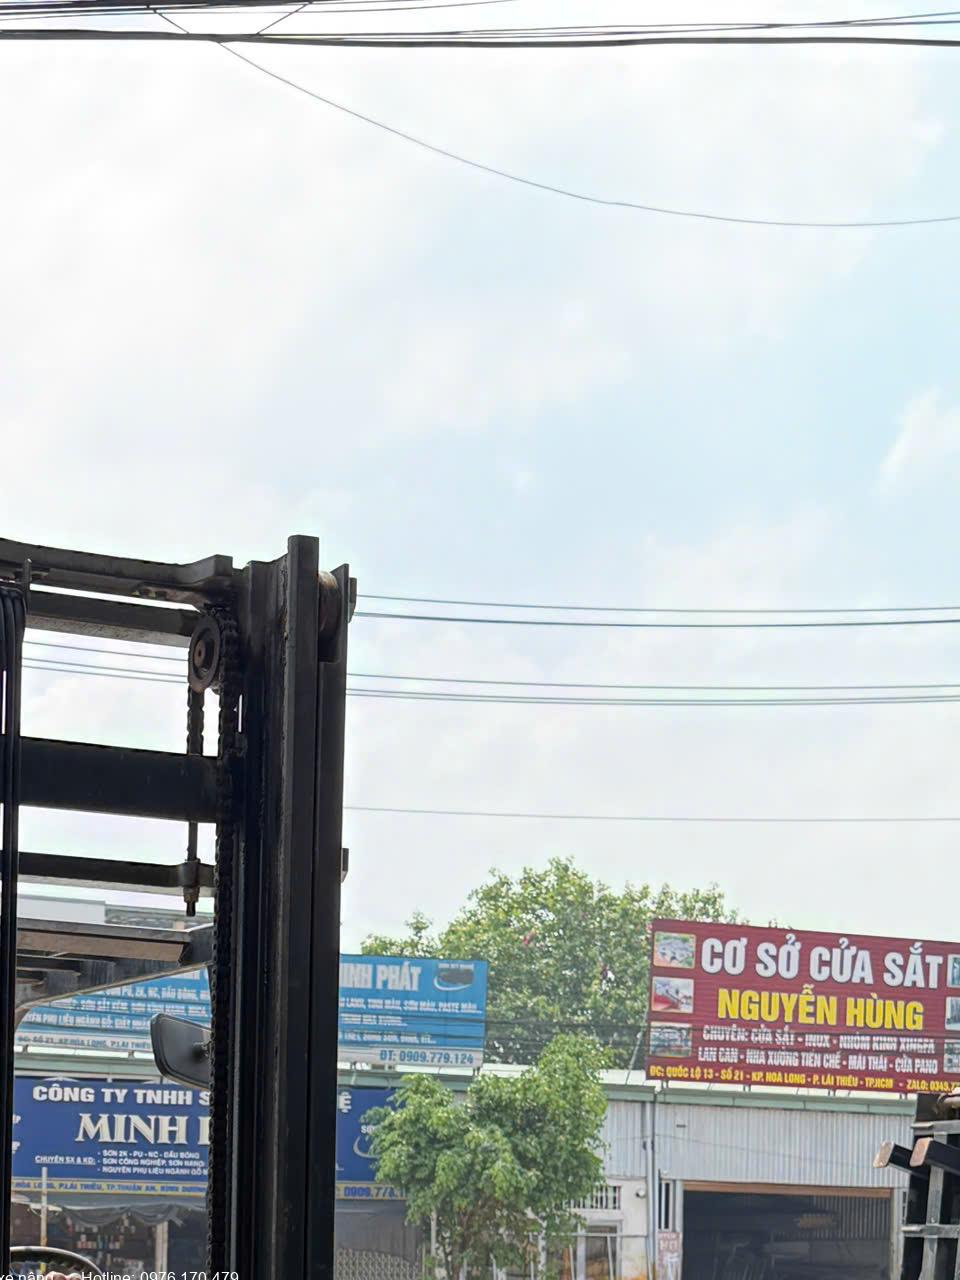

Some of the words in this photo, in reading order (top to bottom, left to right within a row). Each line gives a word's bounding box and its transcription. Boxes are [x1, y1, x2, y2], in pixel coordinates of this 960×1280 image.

[376, 960, 422, 991] PHÁT
[701, 937, 748, 976] CƠ
[755, 933, 801, 980] SỞ
[809, 937, 874, 985] CỬA
[883, 942, 943, 989] SẮT
[717, 983, 837, 1026] NGUYỄN
[846, 993, 925, 1031] HÙNG
[399, 1050, 475, 1065] 0909.779.124
[703, 1068, 714, 1079] 13
[32, 1083, 95, 1102] CÔNG
[101, 1088, 128, 1103] TY
[133, 1089, 193, 1105] TNHH
[75, 1112, 188, 1145] MINH
